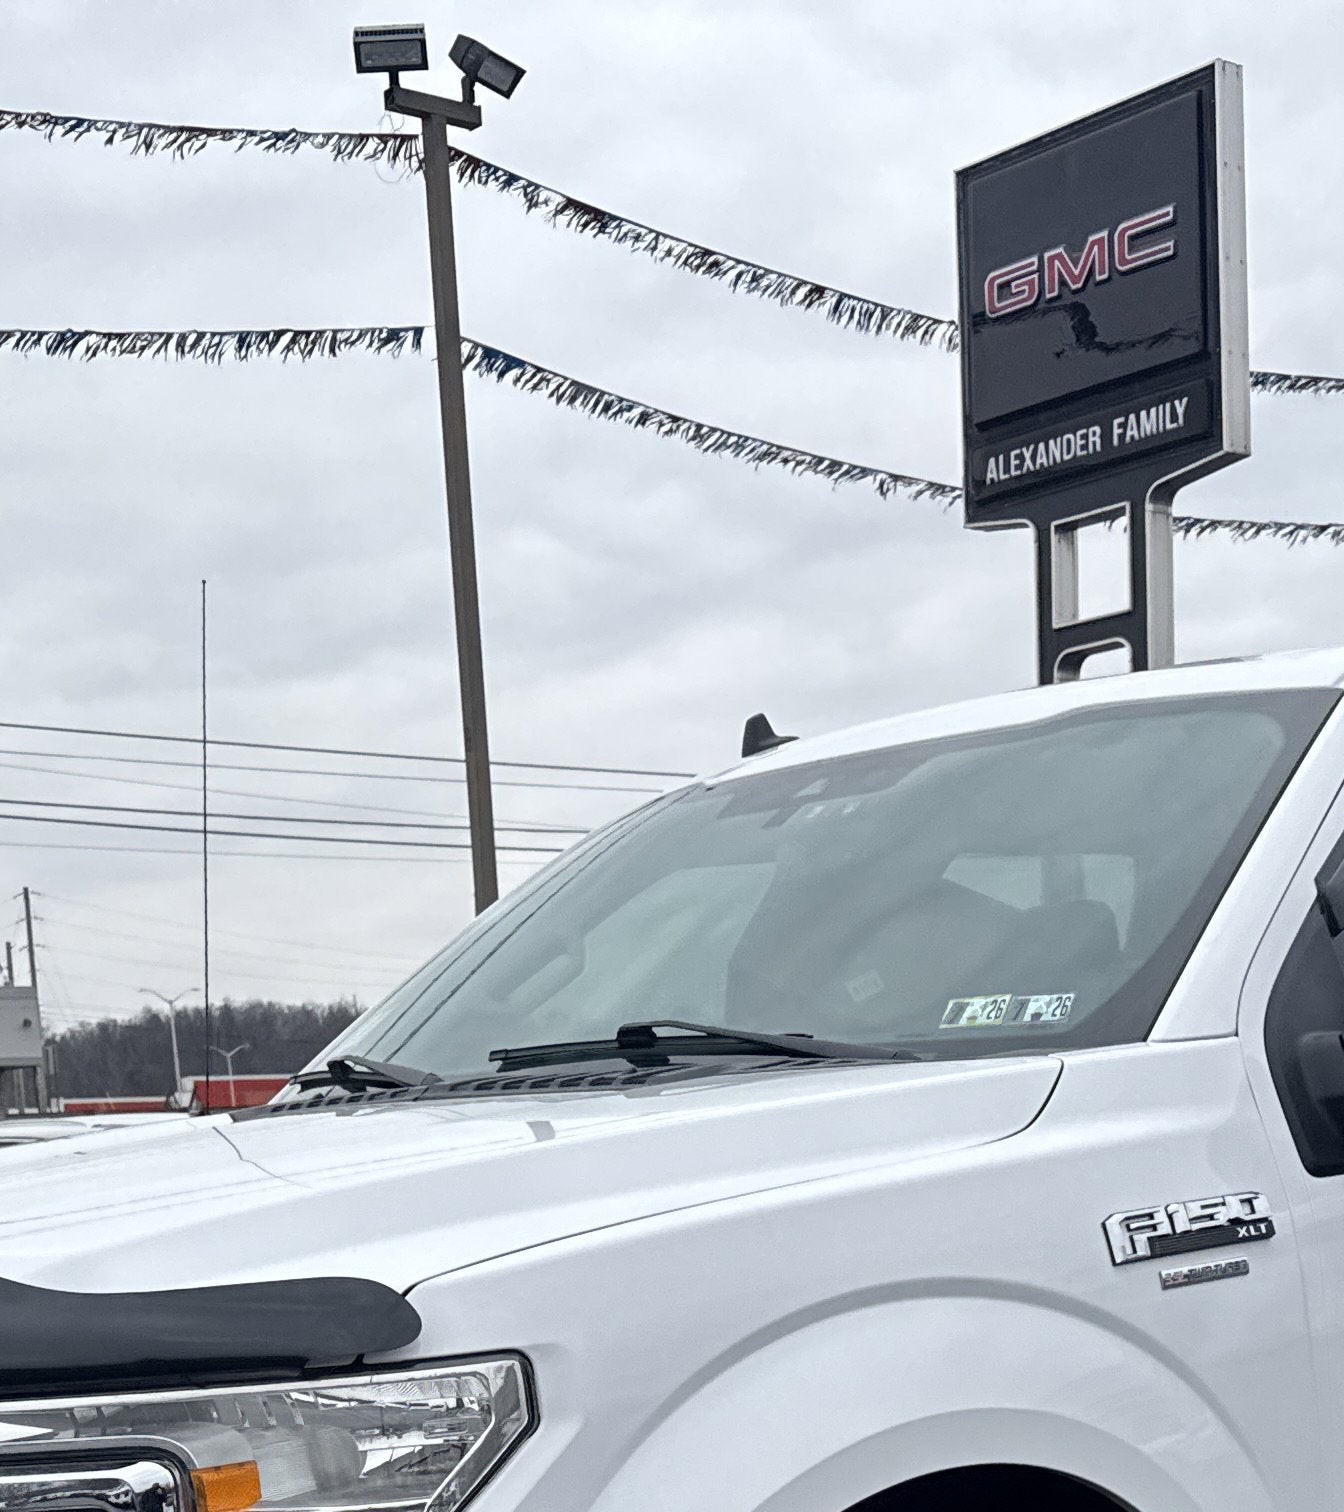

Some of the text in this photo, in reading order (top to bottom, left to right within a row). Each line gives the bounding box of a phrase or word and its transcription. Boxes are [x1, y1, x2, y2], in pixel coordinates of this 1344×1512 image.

[985, 203, 1175, 317] GMC
[986, 397, 1188, 485] ALEXANDER FAMILY
[986, 999, 1006, 1021] 26
[1051, 996, 1072, 1018] 26
[1236, 1223, 1269, 1238] XLT
